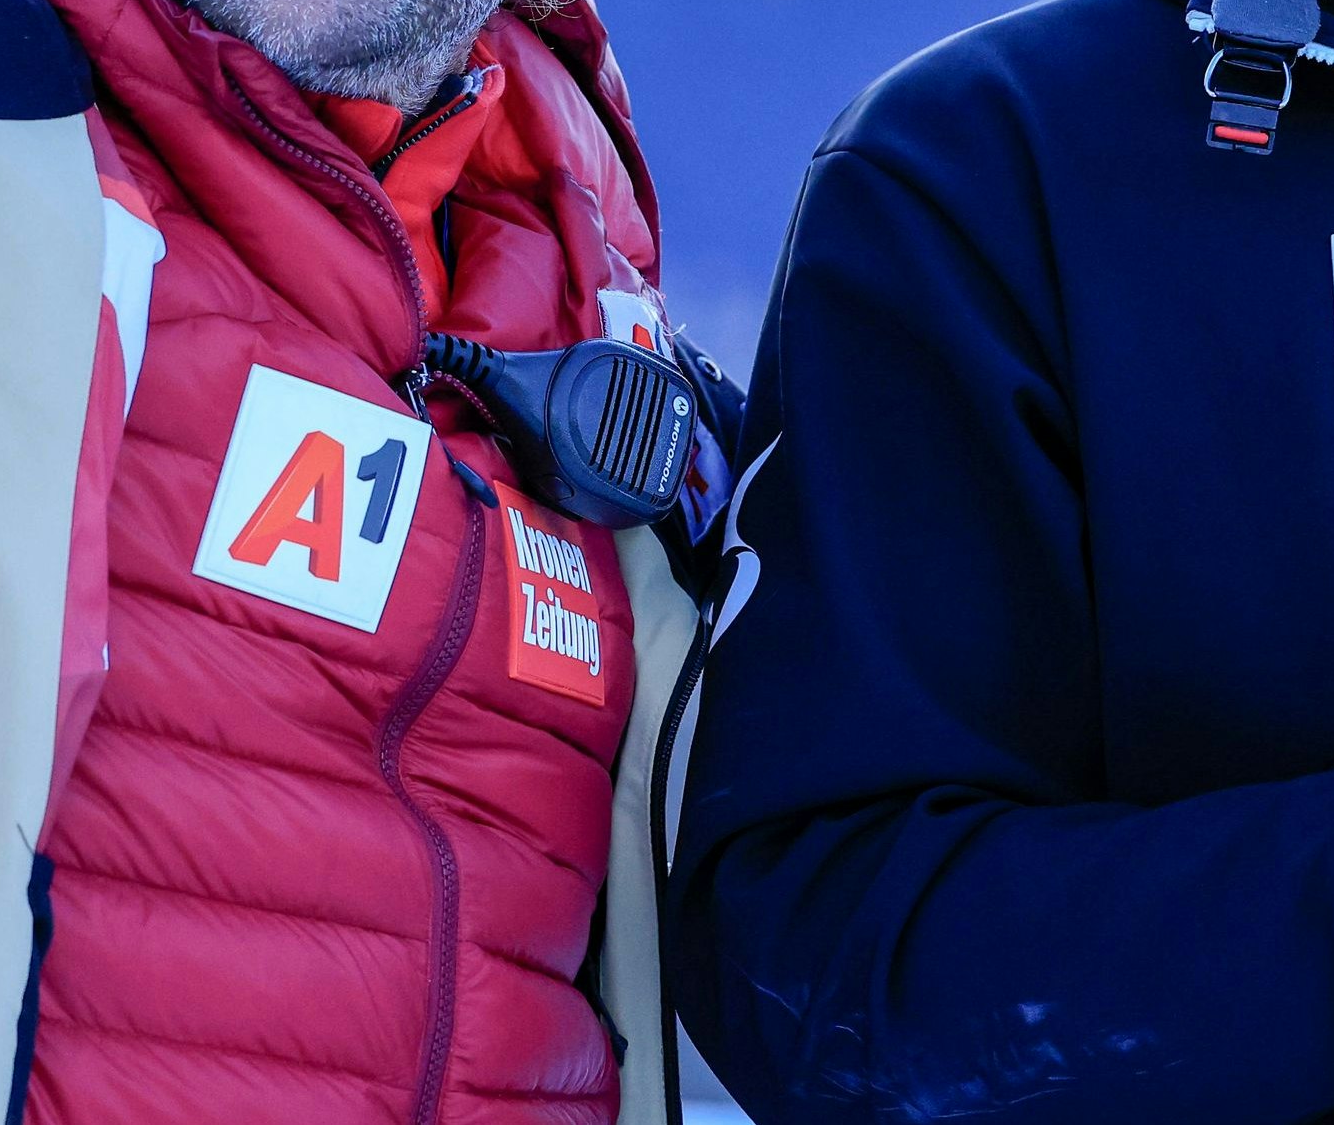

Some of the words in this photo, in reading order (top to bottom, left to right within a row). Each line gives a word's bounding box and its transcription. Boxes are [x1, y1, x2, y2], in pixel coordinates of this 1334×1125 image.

[657, 419, 682, 494] MOTOROLA
[228, 430, 407, 582] A1
[507, 506, 592, 595] Kronen
[521, 581, 602, 677] Zeitung
